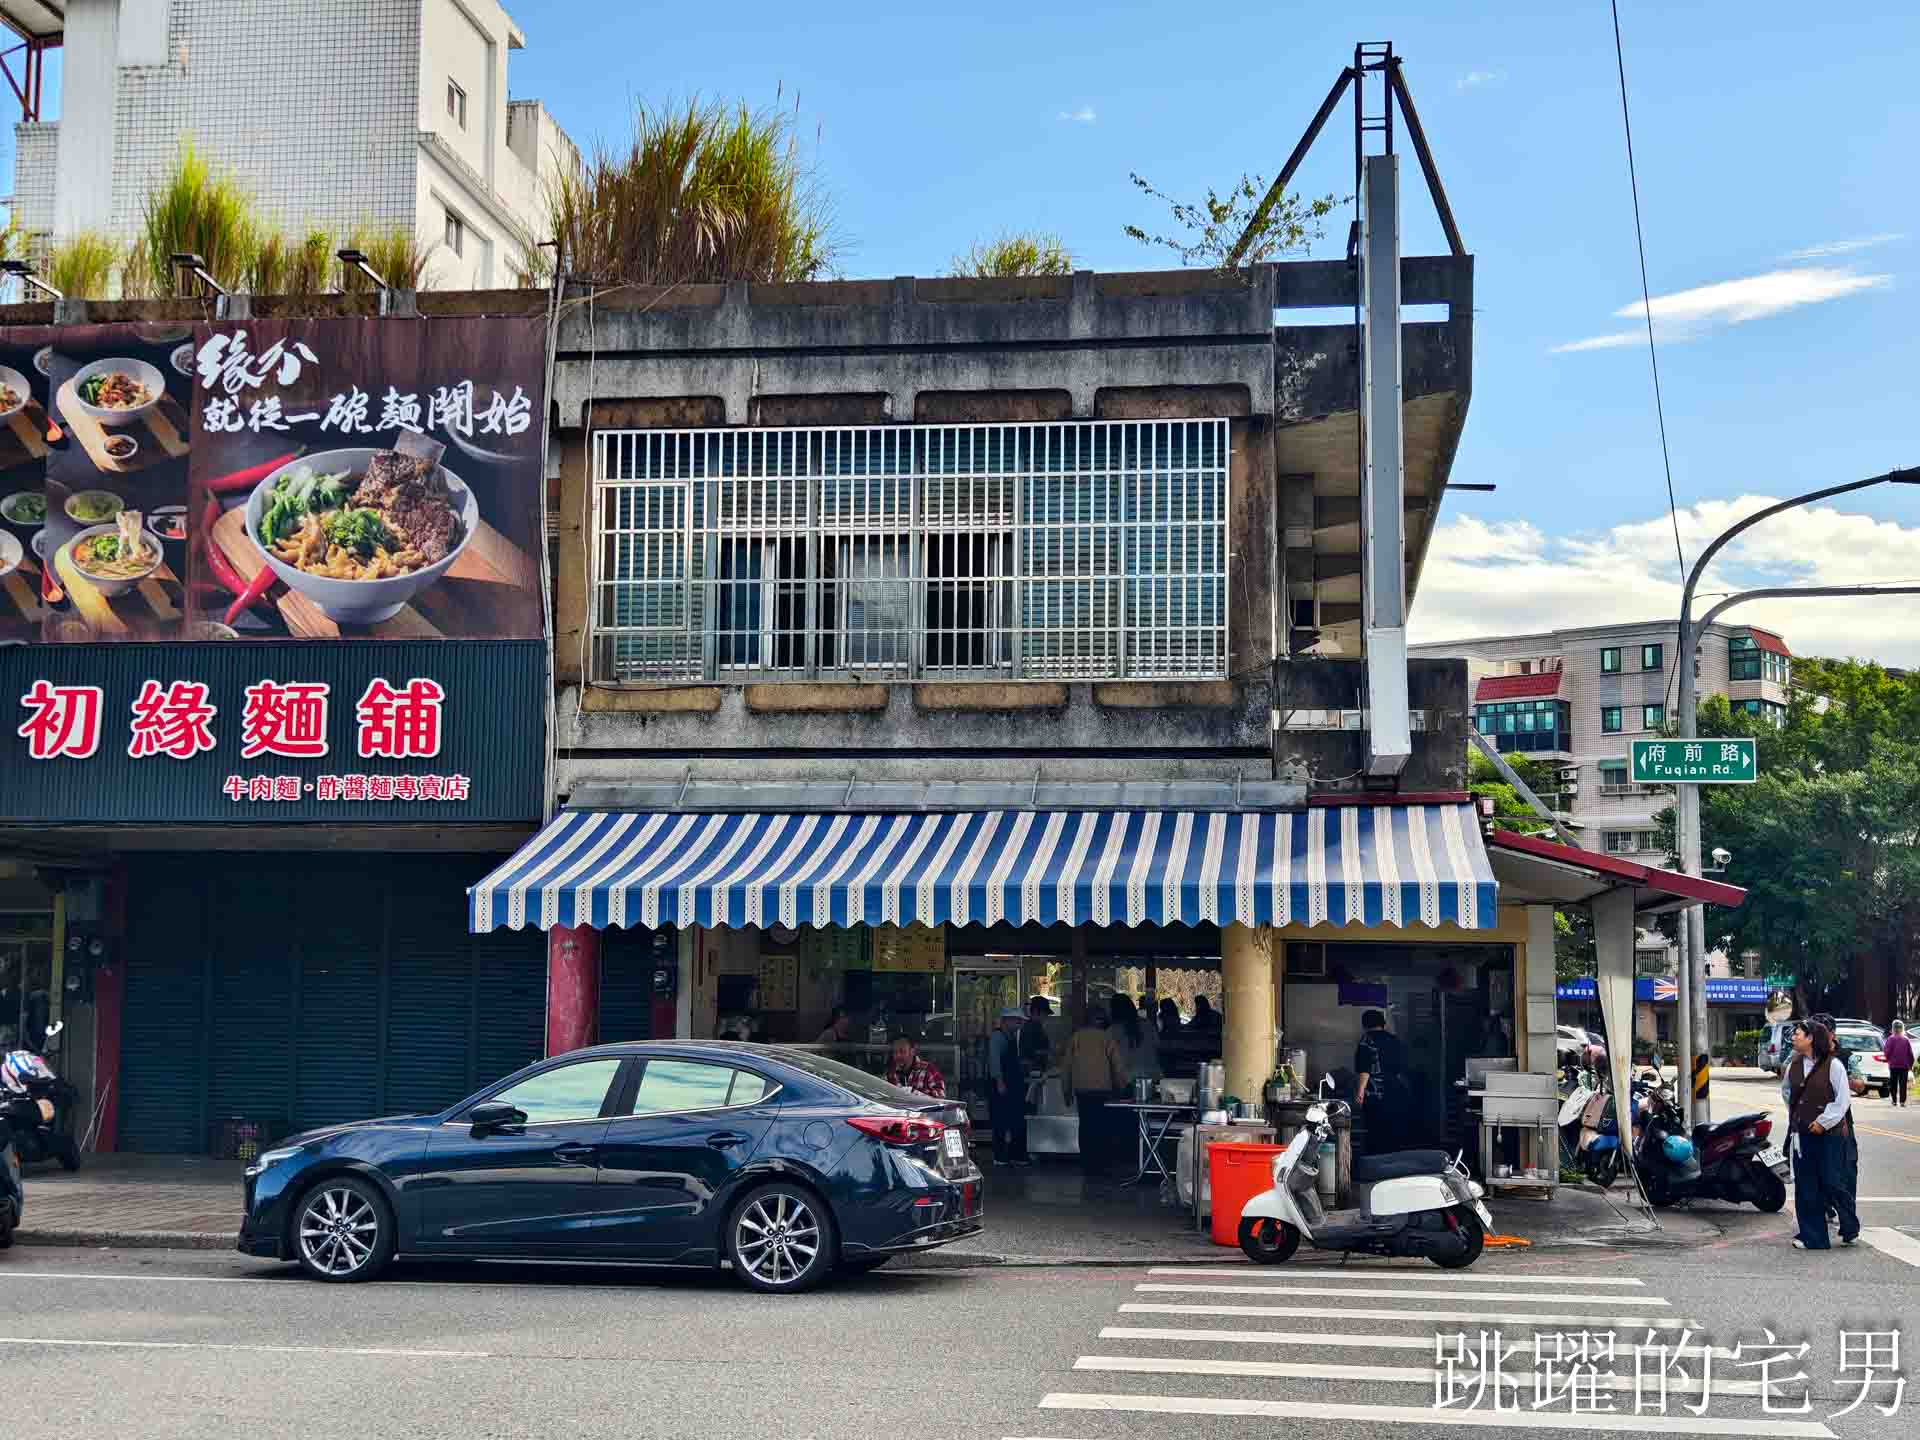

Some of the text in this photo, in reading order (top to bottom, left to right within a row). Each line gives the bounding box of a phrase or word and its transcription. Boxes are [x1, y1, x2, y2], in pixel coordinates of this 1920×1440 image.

[196, 329, 319, 394] 緣分
[17, 678, 445, 760] 初緣麵舖
[1648, 744, 1739, 762] 府前路
[1654, 764, 1734, 776] Fuqian Rd.
